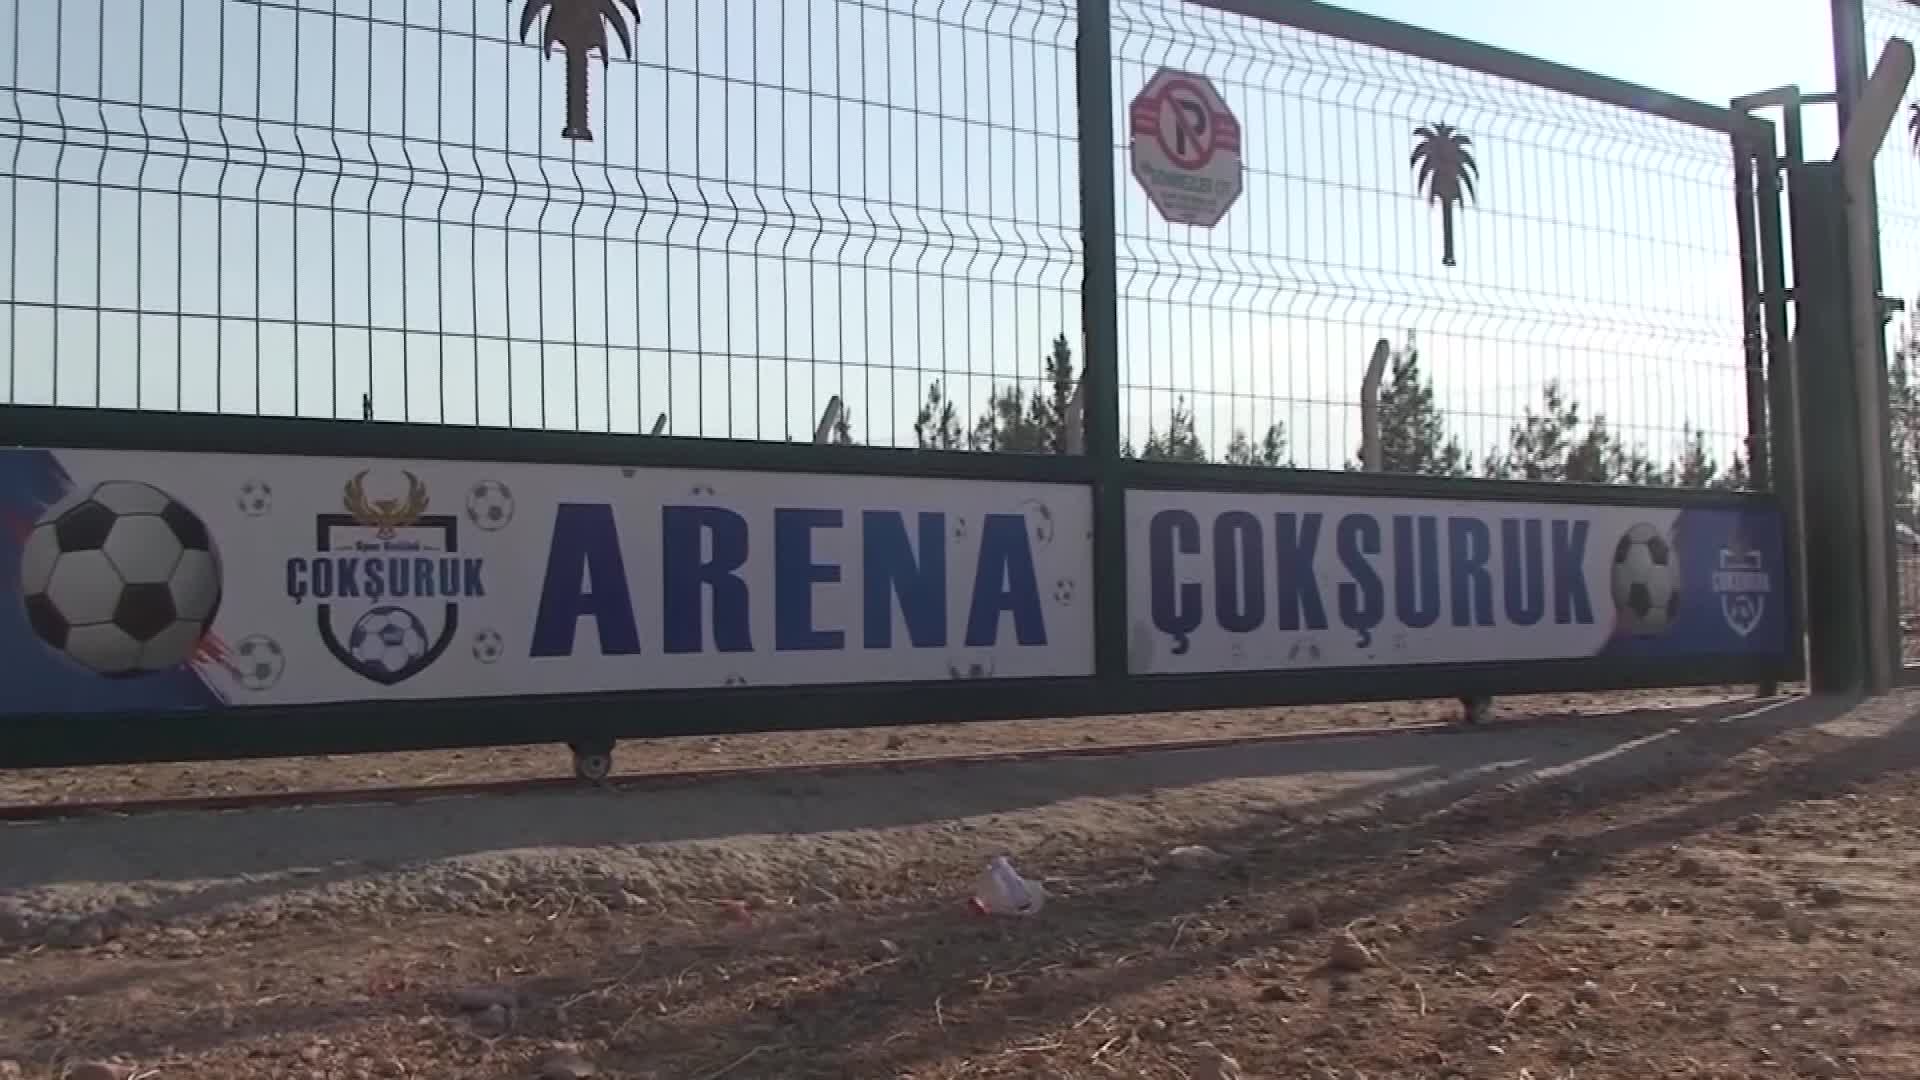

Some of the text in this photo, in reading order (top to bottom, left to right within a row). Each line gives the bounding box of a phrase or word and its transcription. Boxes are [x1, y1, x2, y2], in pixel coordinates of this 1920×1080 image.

[287, 557, 486, 605] ÇOKŞURUK
[529, 503, 1595, 657] ARENA ÇOKŞURUK
